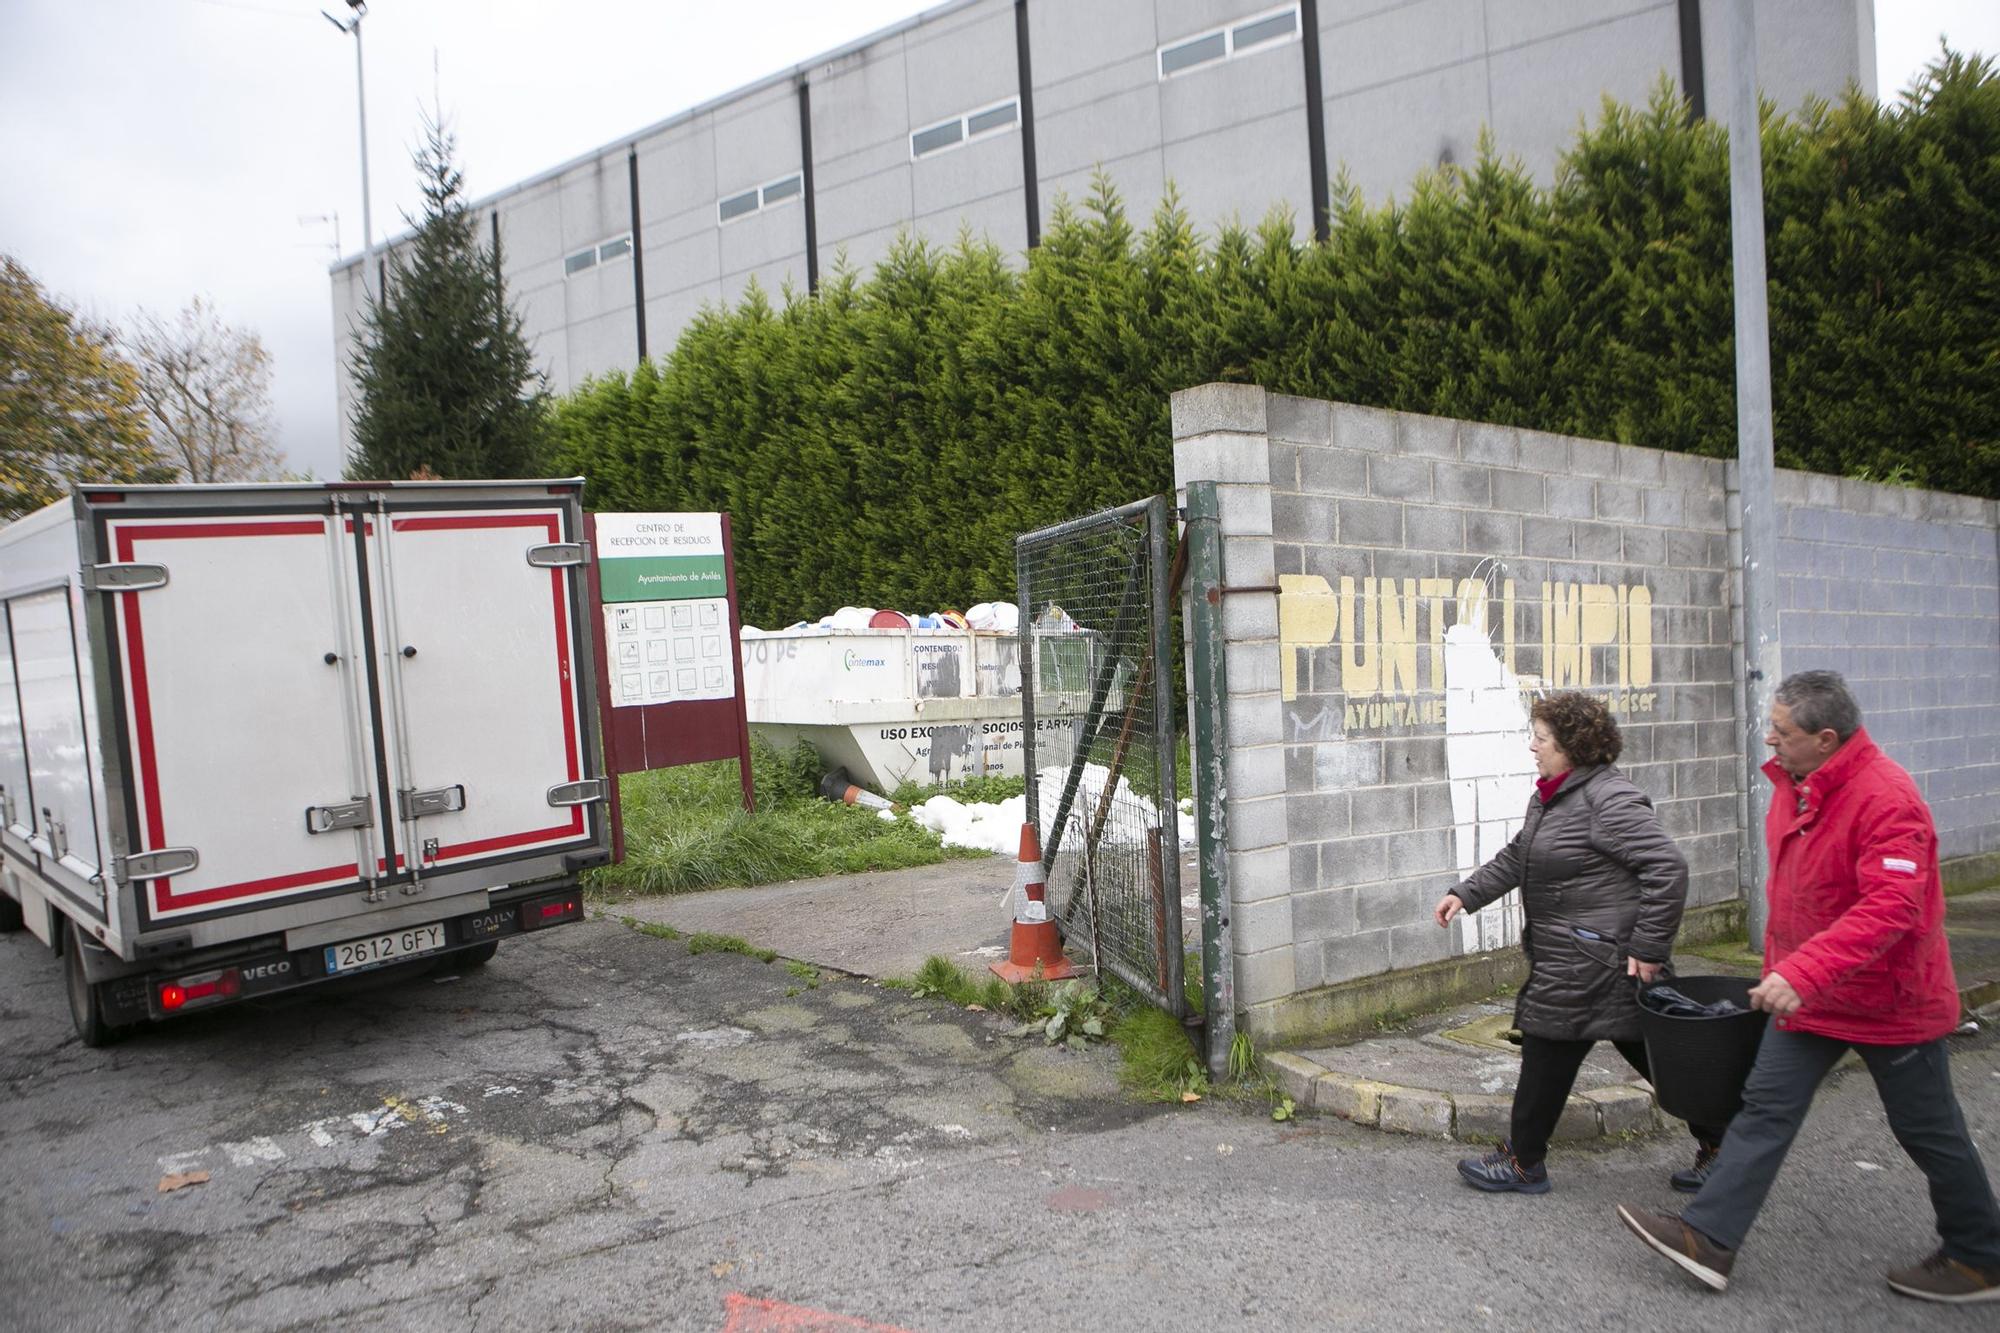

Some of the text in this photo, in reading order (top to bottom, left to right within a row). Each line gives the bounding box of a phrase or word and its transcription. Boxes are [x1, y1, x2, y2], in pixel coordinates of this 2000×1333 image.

[636, 523, 685, 533] CENTRO DE
[659, 536, 669, 545] DE
[673, 535, 712, 545] RESIDUOS
[637, 570, 721, 585] Ayuntamiento de Avilés
[914, 644, 963, 653] CONTENEDO
[880, 728, 907, 740] USO
[472, 909, 516, 929] DAILY
[341, 926, 439, 966] 2612 GFY
